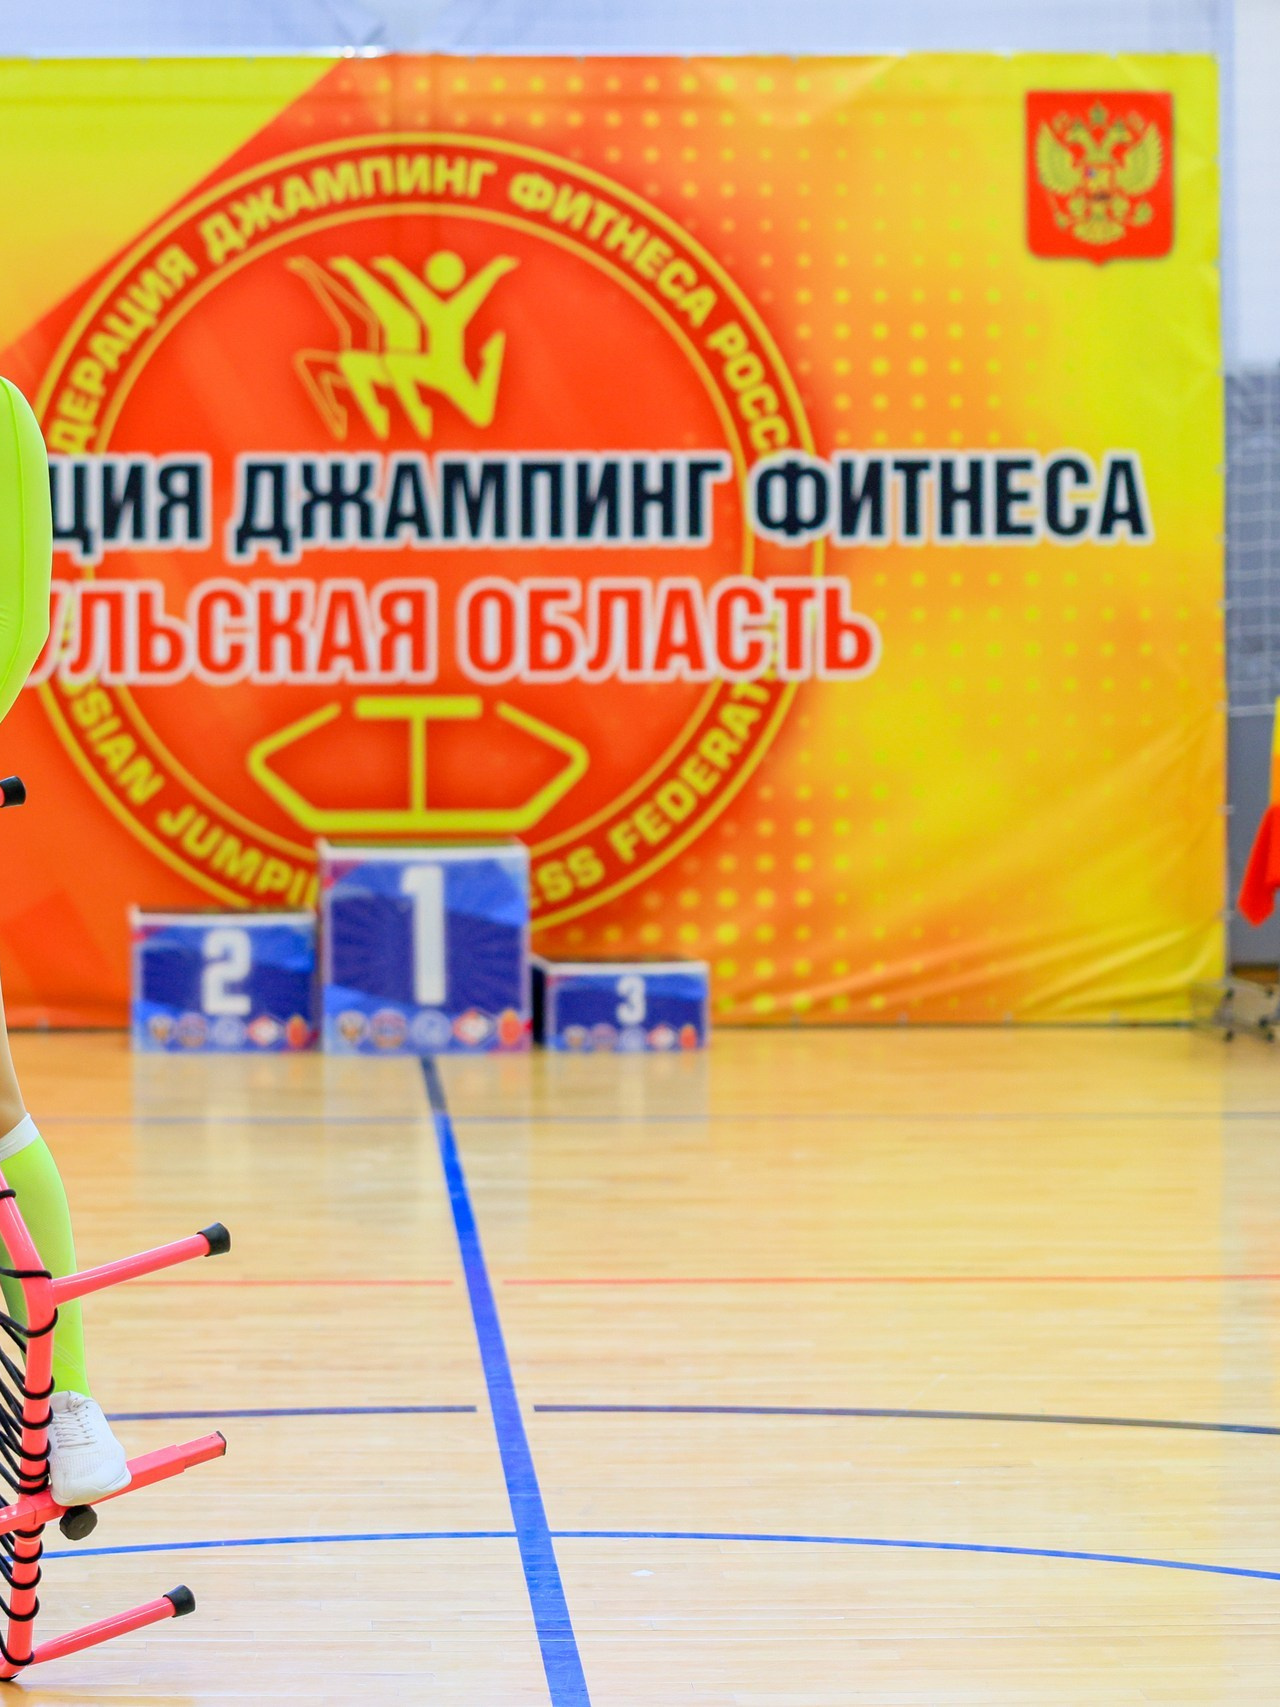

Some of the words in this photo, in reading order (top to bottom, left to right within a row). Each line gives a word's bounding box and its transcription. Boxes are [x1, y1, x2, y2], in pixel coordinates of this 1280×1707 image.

[47, 244, 199, 456] ДЕРАЦИЯ
[197, 154, 498, 264] ДЖАМПИНГ
[507, 171, 719, 328] ФИТНЕСА
[707, 321, 791, 460] РОСС
[233, 459, 726, 556] ДЖАМПИНГ
[754, 457, 1151, 538] ФИТНЕСА
[28, 584, 428, 678] ЛЬСКАЯ
[464, 583, 875, 677] ОБЛАСТЬ
[60, 668, 165, 807] SIAN
[156, 804, 320, 910] JUMPI
[607, 678, 772, 863] FEDERAT
[201, 930, 251, 1015] 2
[402, 864, 446, 1005] 1
[616, 976, 646, 1024] 3
